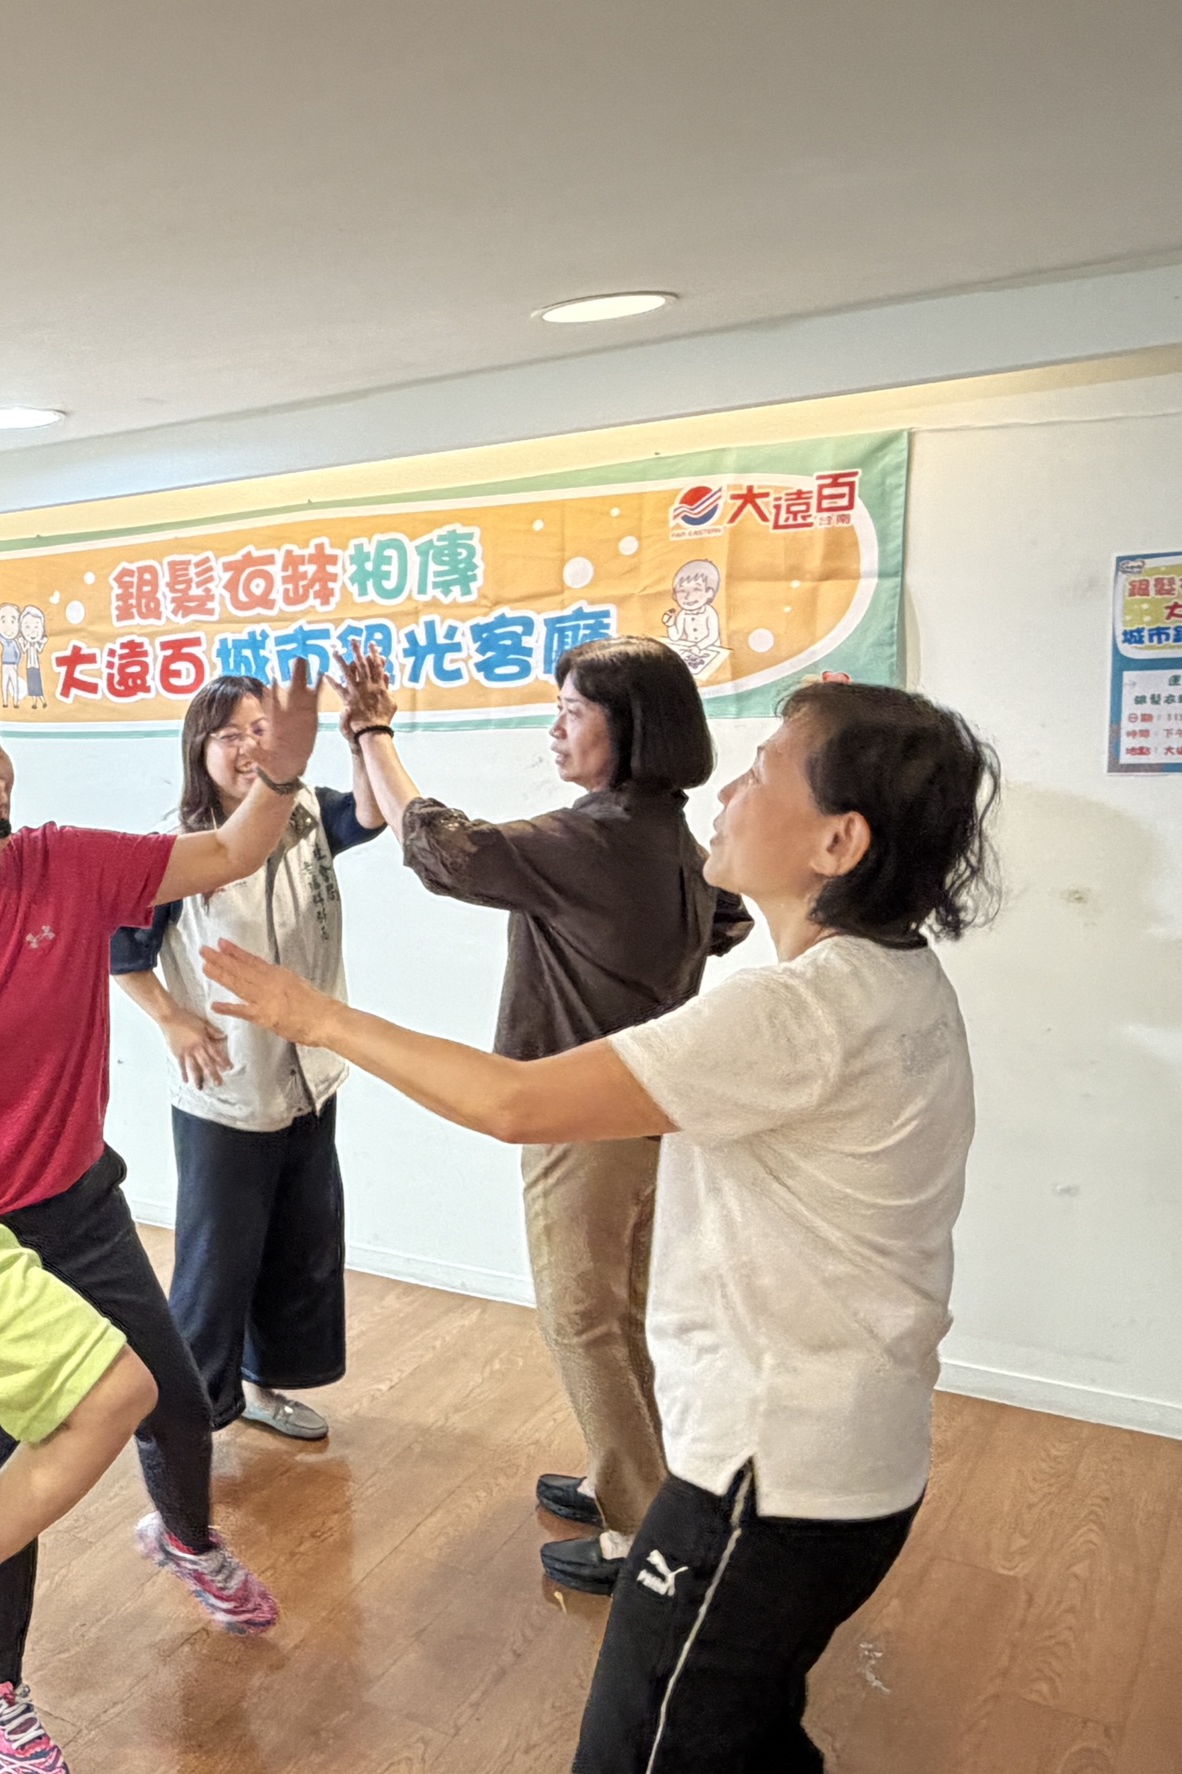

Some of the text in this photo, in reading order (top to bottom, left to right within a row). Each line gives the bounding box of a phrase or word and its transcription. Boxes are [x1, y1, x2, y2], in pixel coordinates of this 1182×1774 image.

[727, 471, 859, 530] 大遠百
[1127, 576, 1182, 597] 銀髮
